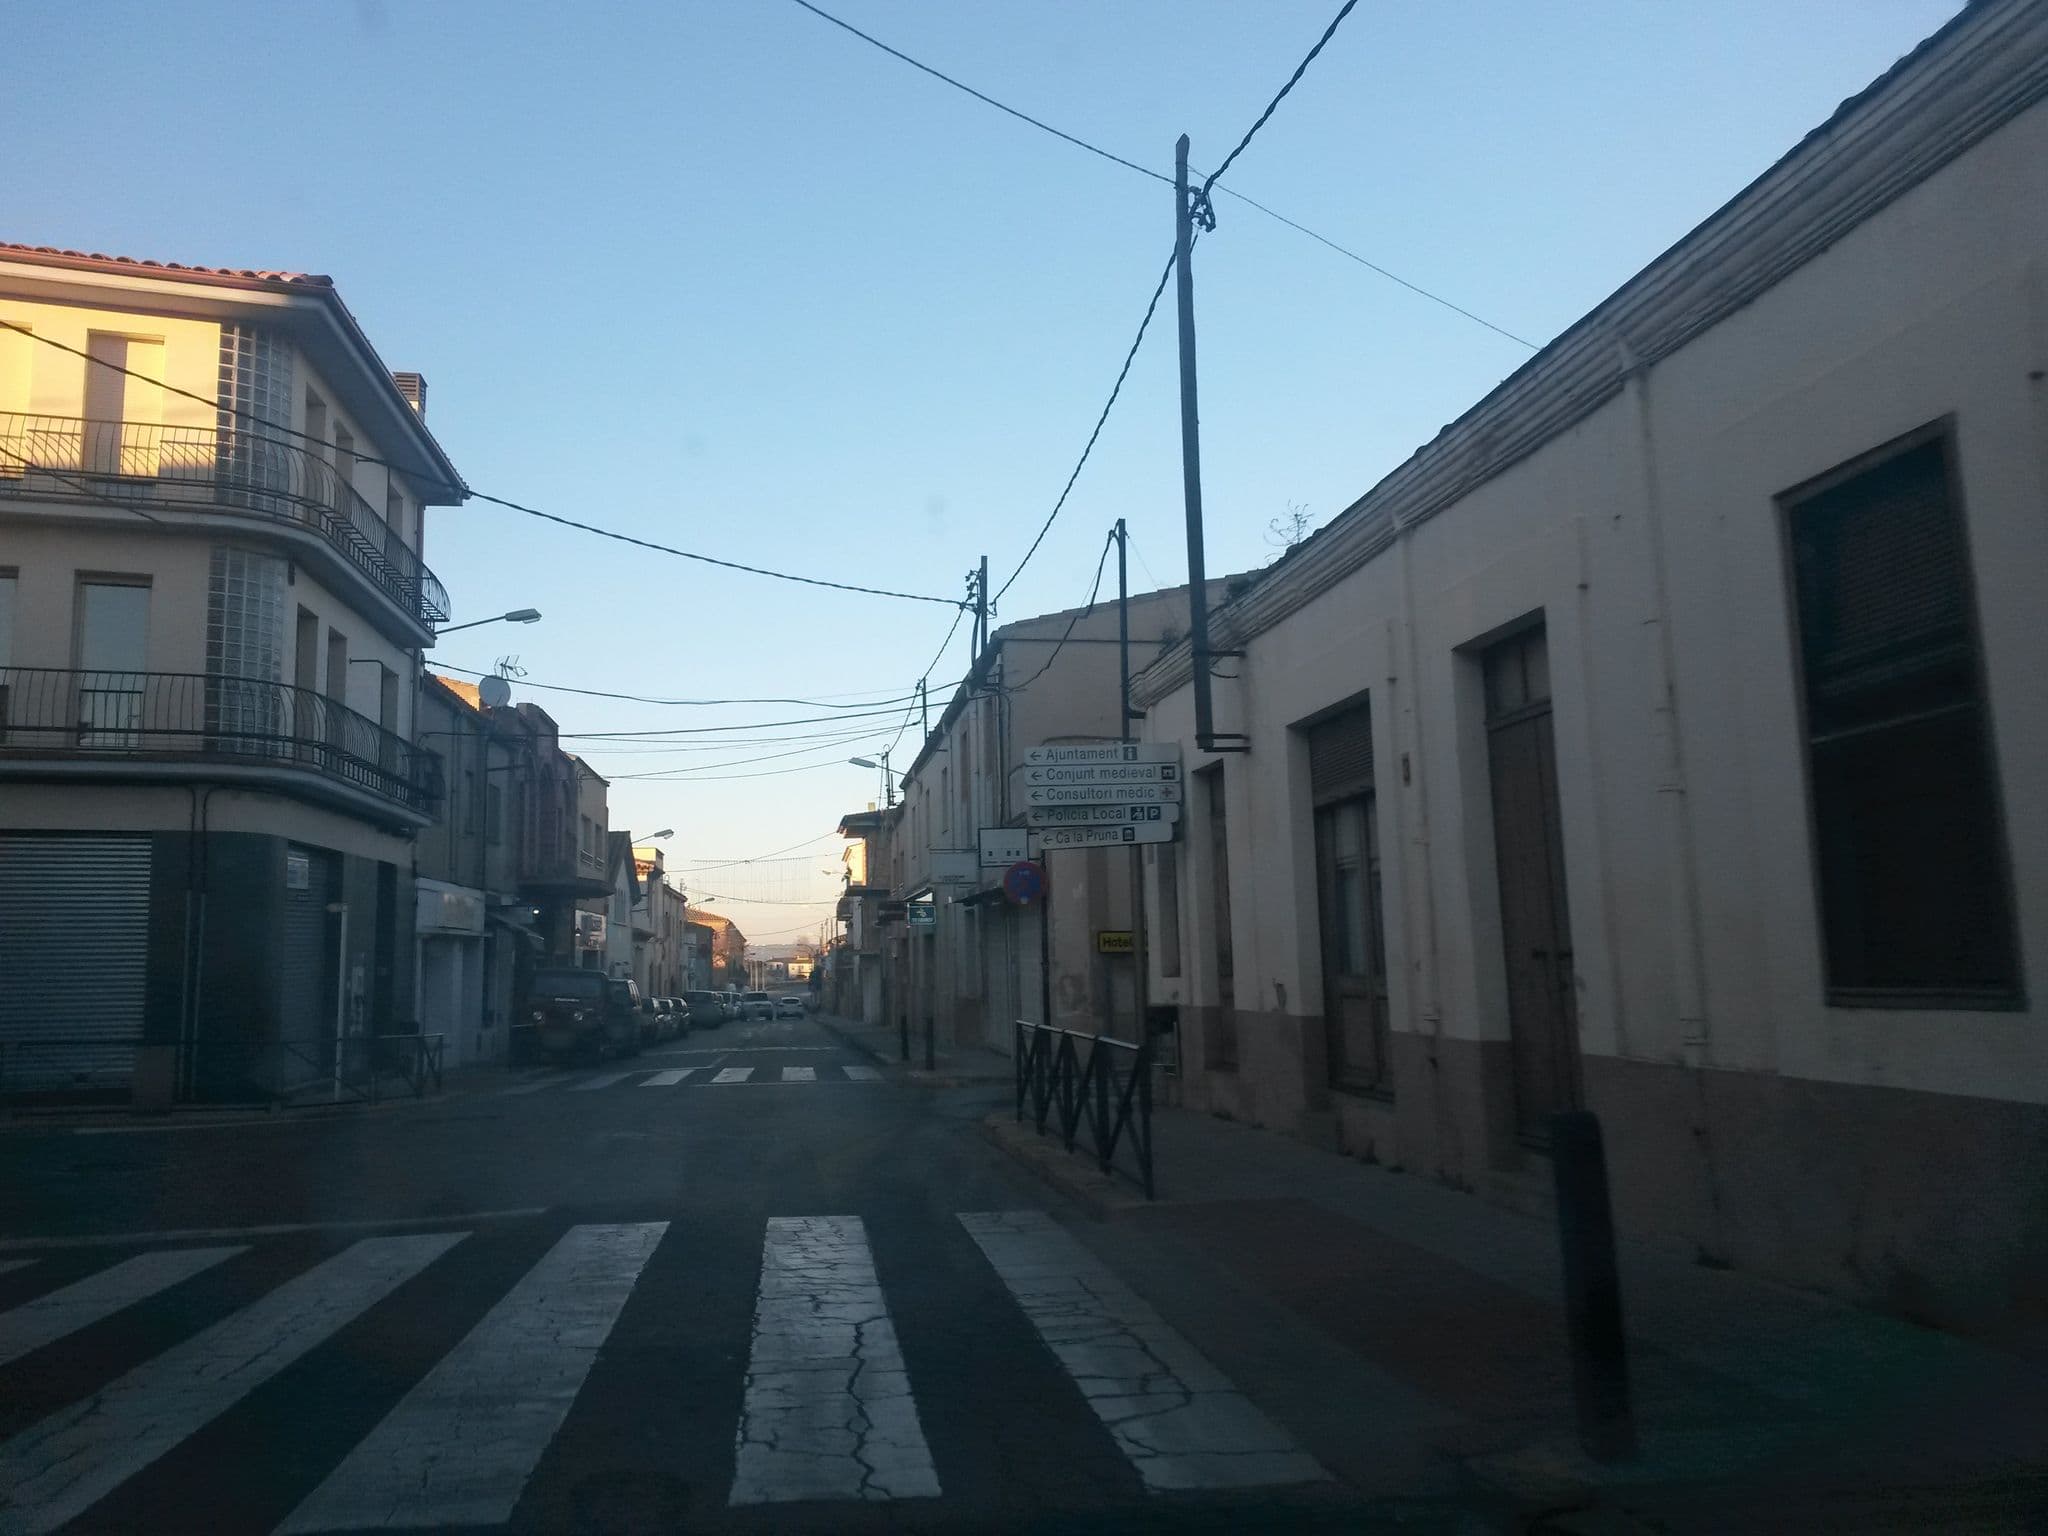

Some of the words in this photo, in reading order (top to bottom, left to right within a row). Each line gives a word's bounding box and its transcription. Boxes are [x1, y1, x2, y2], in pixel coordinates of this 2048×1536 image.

[1046, 748, 1118, 763] Ajuntament
[1046, 767, 1095, 782] Conjunt
[1099, 766, 1156, 779] medieval
[1046, 787, 1112, 801] Consultori
[1093, 807, 1126, 819] Local
[1056, 831, 1070, 844] Ca
[1073, 832, 1083, 843] la
[1086, 829, 1118, 841] Pruna
